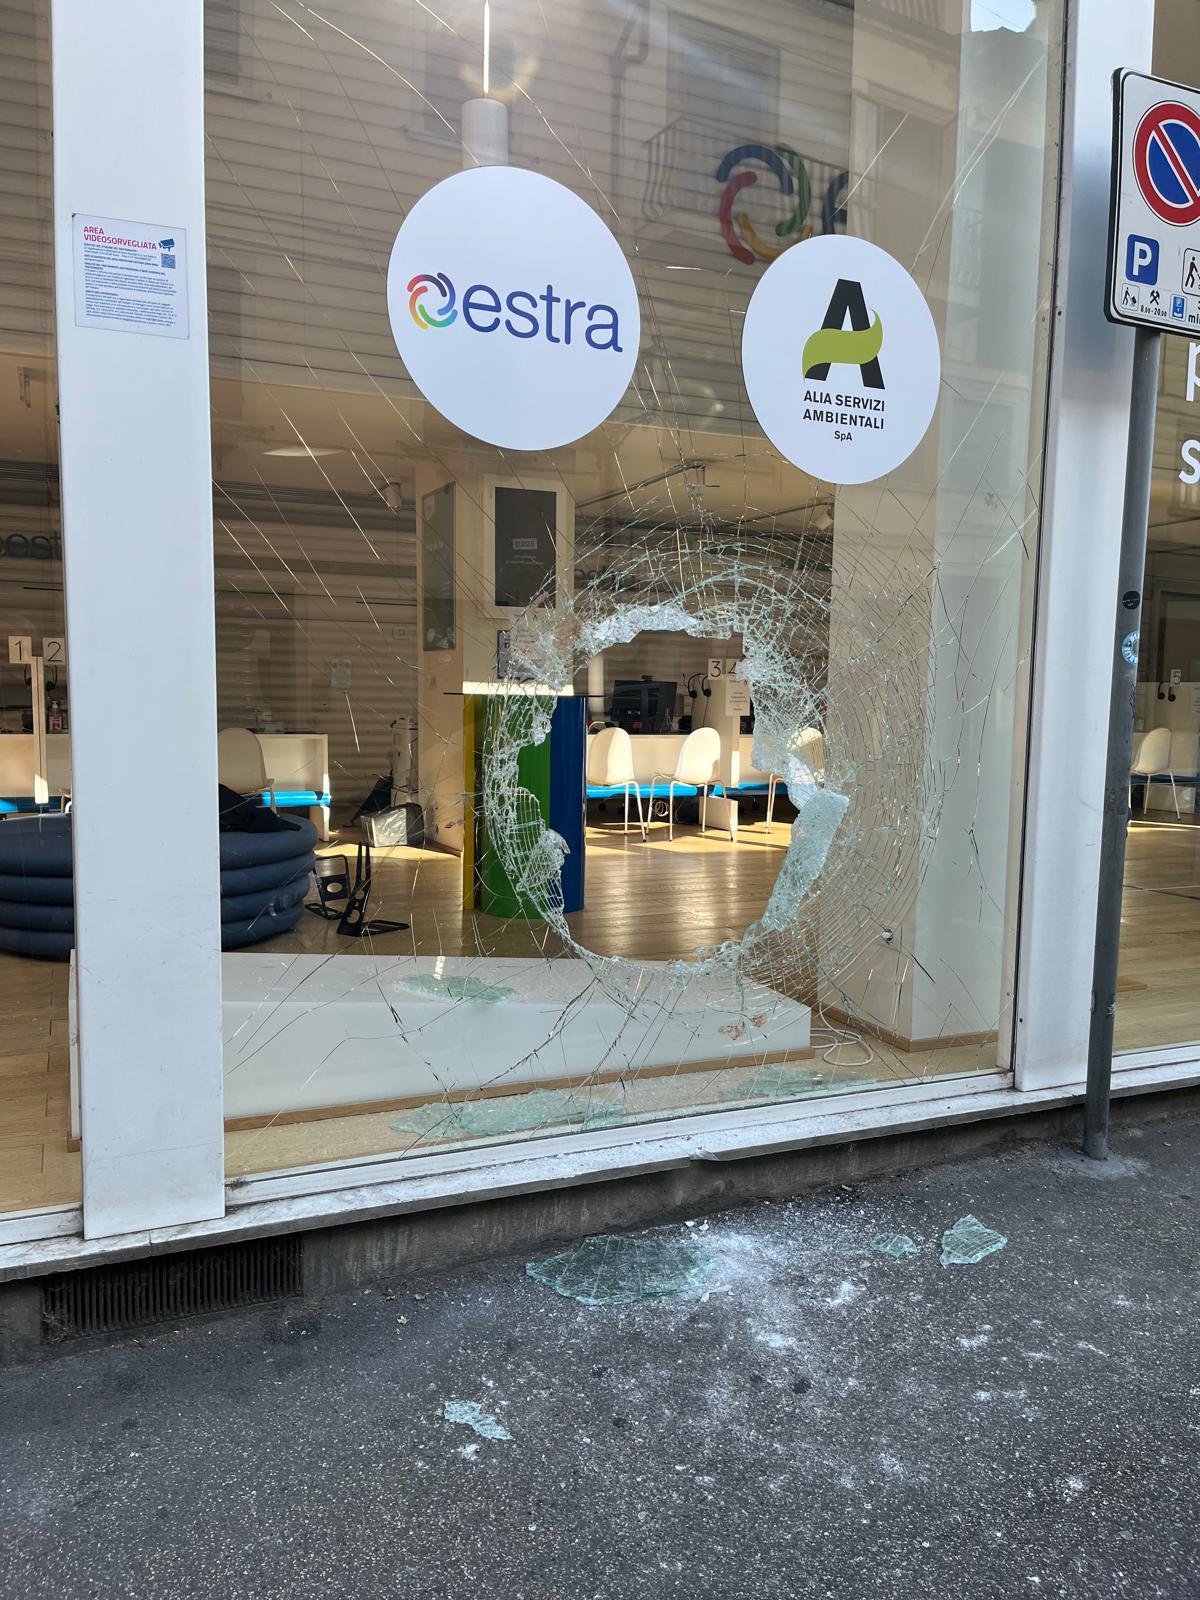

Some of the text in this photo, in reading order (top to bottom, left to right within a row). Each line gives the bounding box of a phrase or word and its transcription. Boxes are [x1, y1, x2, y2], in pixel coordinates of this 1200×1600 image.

[84, 226, 104, 235] AREA
[84, 234, 157, 250] VIDEOSORVEGLIATA
[1132, 241, 1152, 276] P
[462, 284, 623, 352] estra
[803, 389, 885, 412] ALIA SERVIZI
[802, 408, 884, 430] AMBIENTALI
[834, 430, 853, 442] SpA
[15, 640, 22, 661] 1
[47, 641, 63, 662] 2
[710, 660, 722, 678] 3
